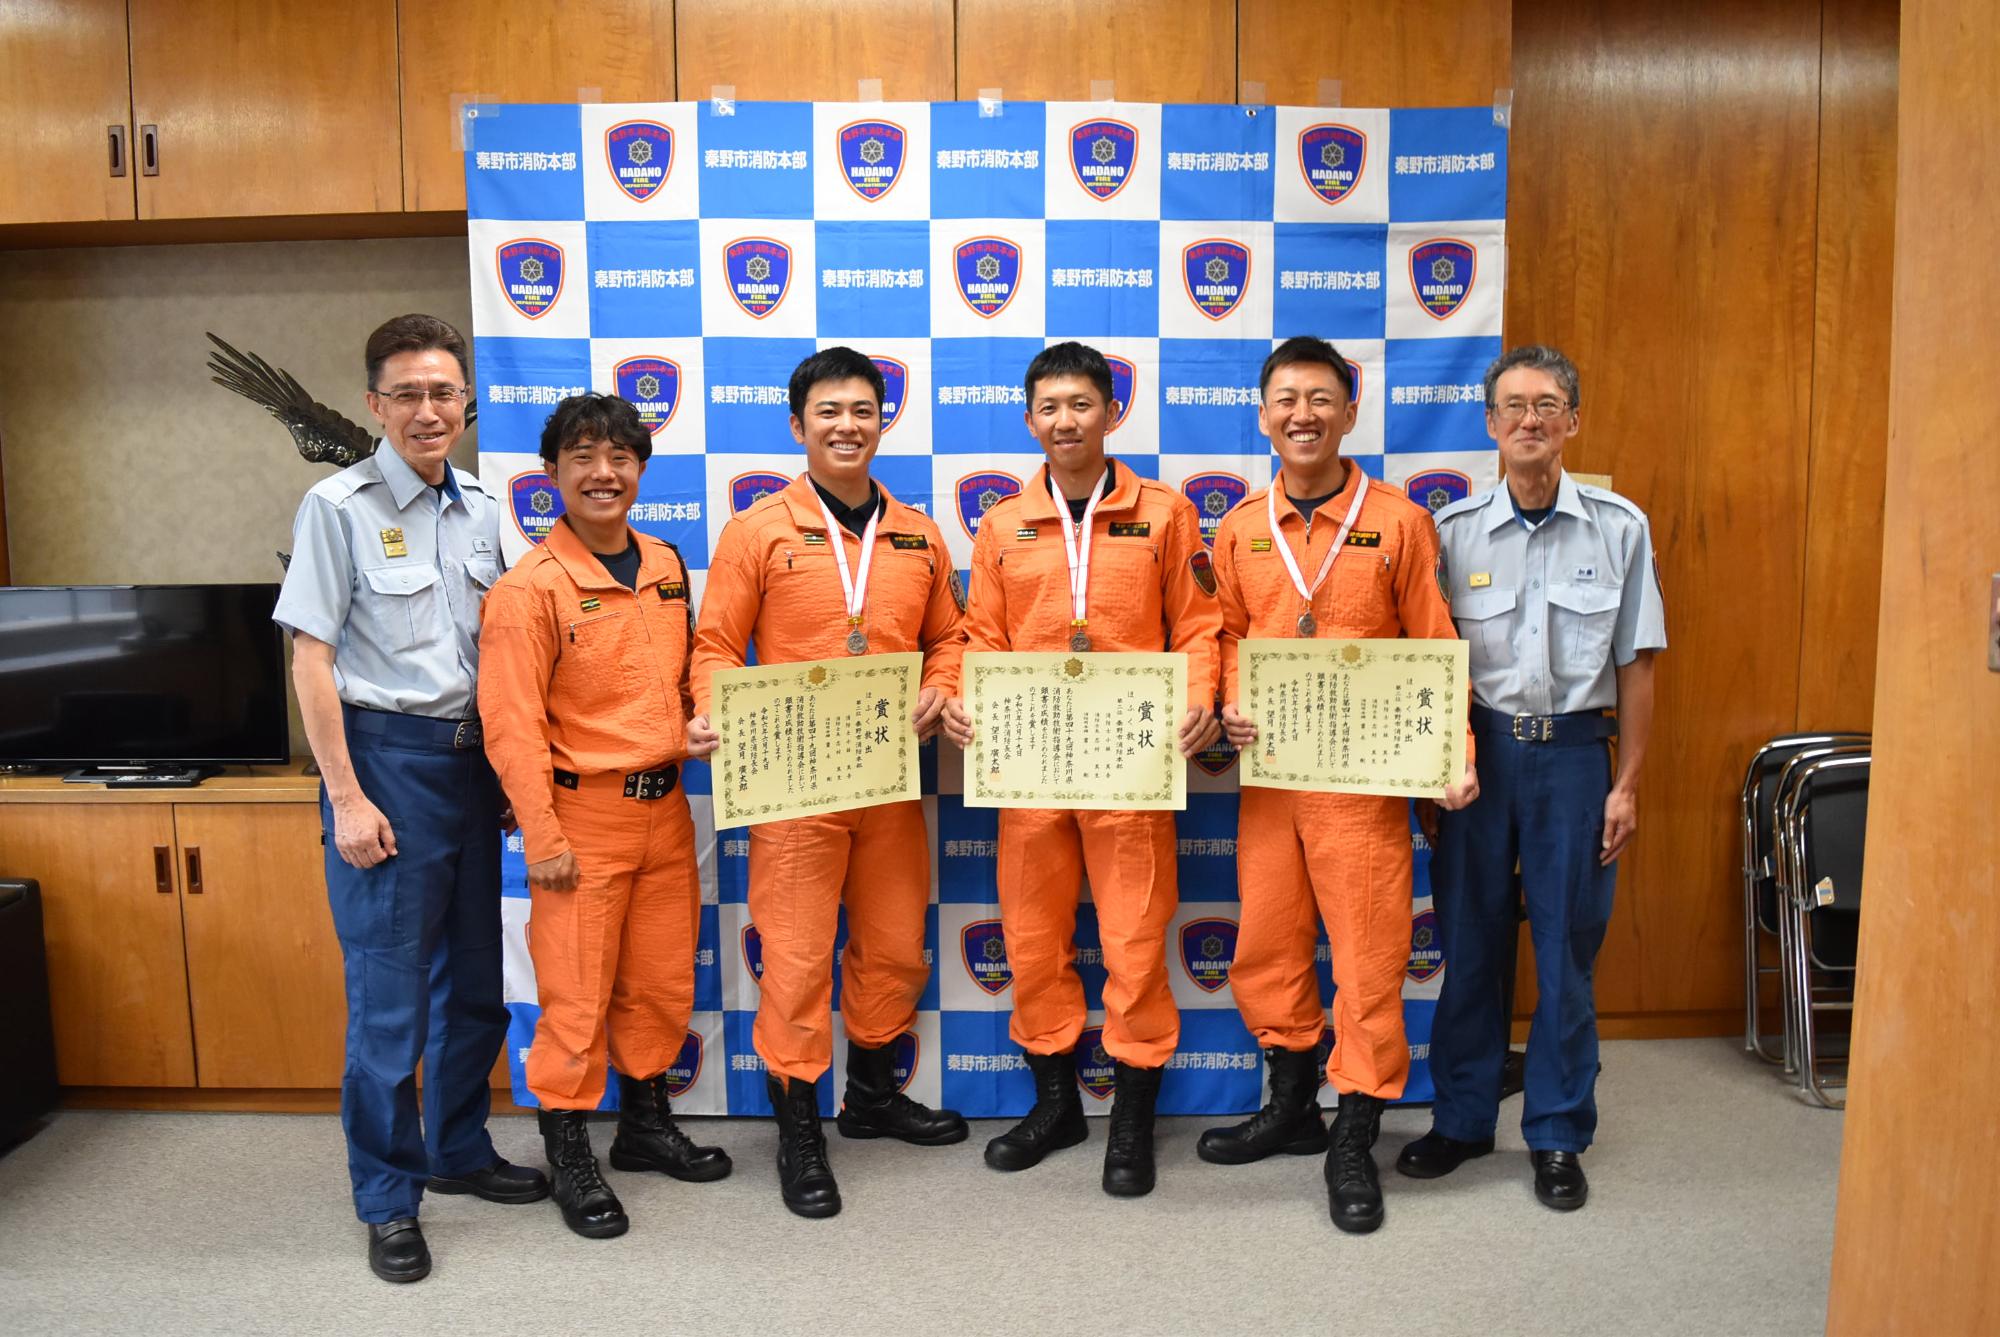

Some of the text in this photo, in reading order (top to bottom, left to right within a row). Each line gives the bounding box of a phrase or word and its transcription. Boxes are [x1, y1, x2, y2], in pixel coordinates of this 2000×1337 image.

[477, 152, 576, 171] 秦野市消防本部
[705, 150, 807, 169] 秦野市消防本部
[937, 149, 1039, 169] 秦野市消防本部
[1168, 152, 1268, 171] 秦野市消防本部
[1395, 152, 1495, 174] 秦野市消防本部
[620, 167, 661, 177] HADANO
[851, 166, 893, 177] HADANO
[1083, 166, 1124, 176] HADANO
[1312, 170, 1352, 180] HADANO
[595, 269, 694, 288] 秦野市消防本部
[822, 269, 923, 288] 秦野市消防本部
[1052, 268, 1152, 287] 秦野市消防本部
[1281, 271, 1380, 290] 秦野市消防本部
[512, 285, 553, 295] HADANO
[738, 284, 779, 294] HADANO
[968, 284, 1009, 293] HADANO
[1196, 285, 1237, 296] HADANO
[1423, 284, 1463, 296] HADANO
[938, 385, 1027, 404] 秦野市消防本
[1166, 386, 1262, 405] 秦野市消防本部
[1391, 384, 1486, 404] 秦野市消防本部
[524, 516, 556, 526] HADAN
[627, 502, 701, 521] 市消防本部
[1267, 687, 1274, 705] 会長
[992, 702, 998, 721] 会長
[1267, 710, 1275, 728] 望月
[1279, 683, 1287, 744] 神奈川県消防長会
[1404, 678, 1413, 743] ほふく救出
[1416, 687, 1434, 736] 賞状
[738, 717, 744, 736] 会長
[874, 699, 890, 744] 賞状
[1127, 691, 1135, 756] ほふく救出
[1138, 700, 1155, 749] 賞状
[750, 713, 758, 775] 神奈川県消防長会
[991, 726, 999, 744] 望月
[738, 743, 746, 760] 望月
[1408, 950, 1441, 960] ADANO
[948, 1054, 1030, 1072] 秦野市消防本
[1083, 1068, 1114, 1078] HADAN
